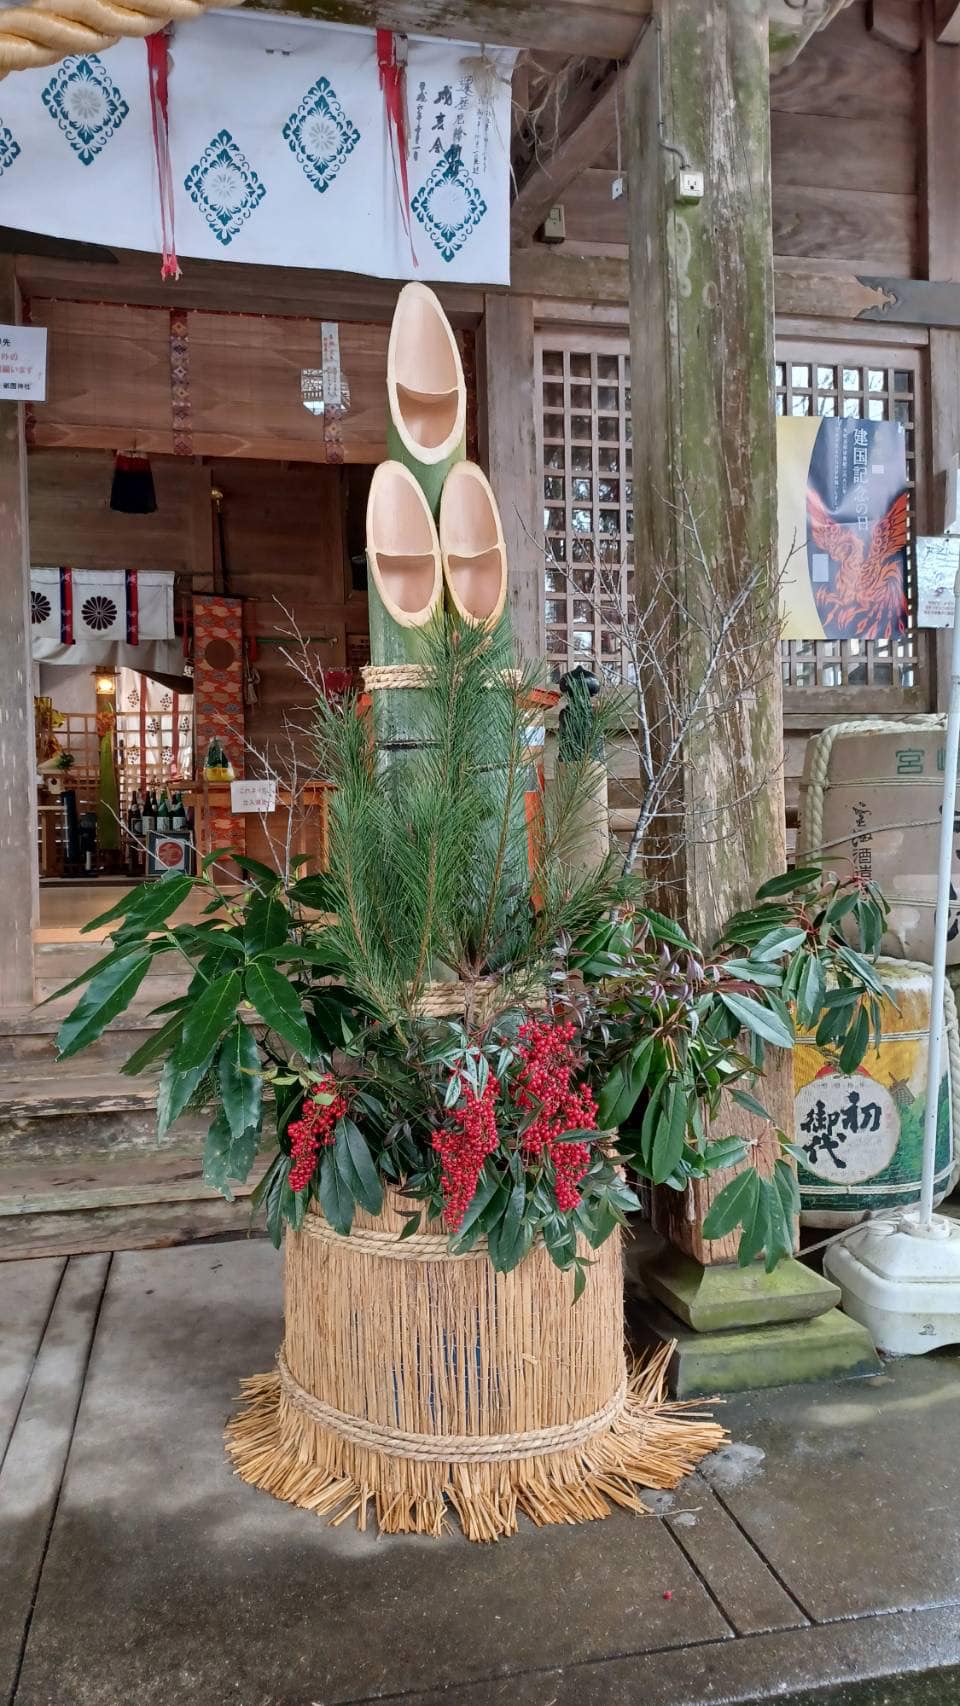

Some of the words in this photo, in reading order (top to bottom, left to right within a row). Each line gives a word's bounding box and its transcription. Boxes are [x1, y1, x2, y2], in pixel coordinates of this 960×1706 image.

[0, 337, 11, 347] 先
[853, 428, 868, 530] 建国記念の日
